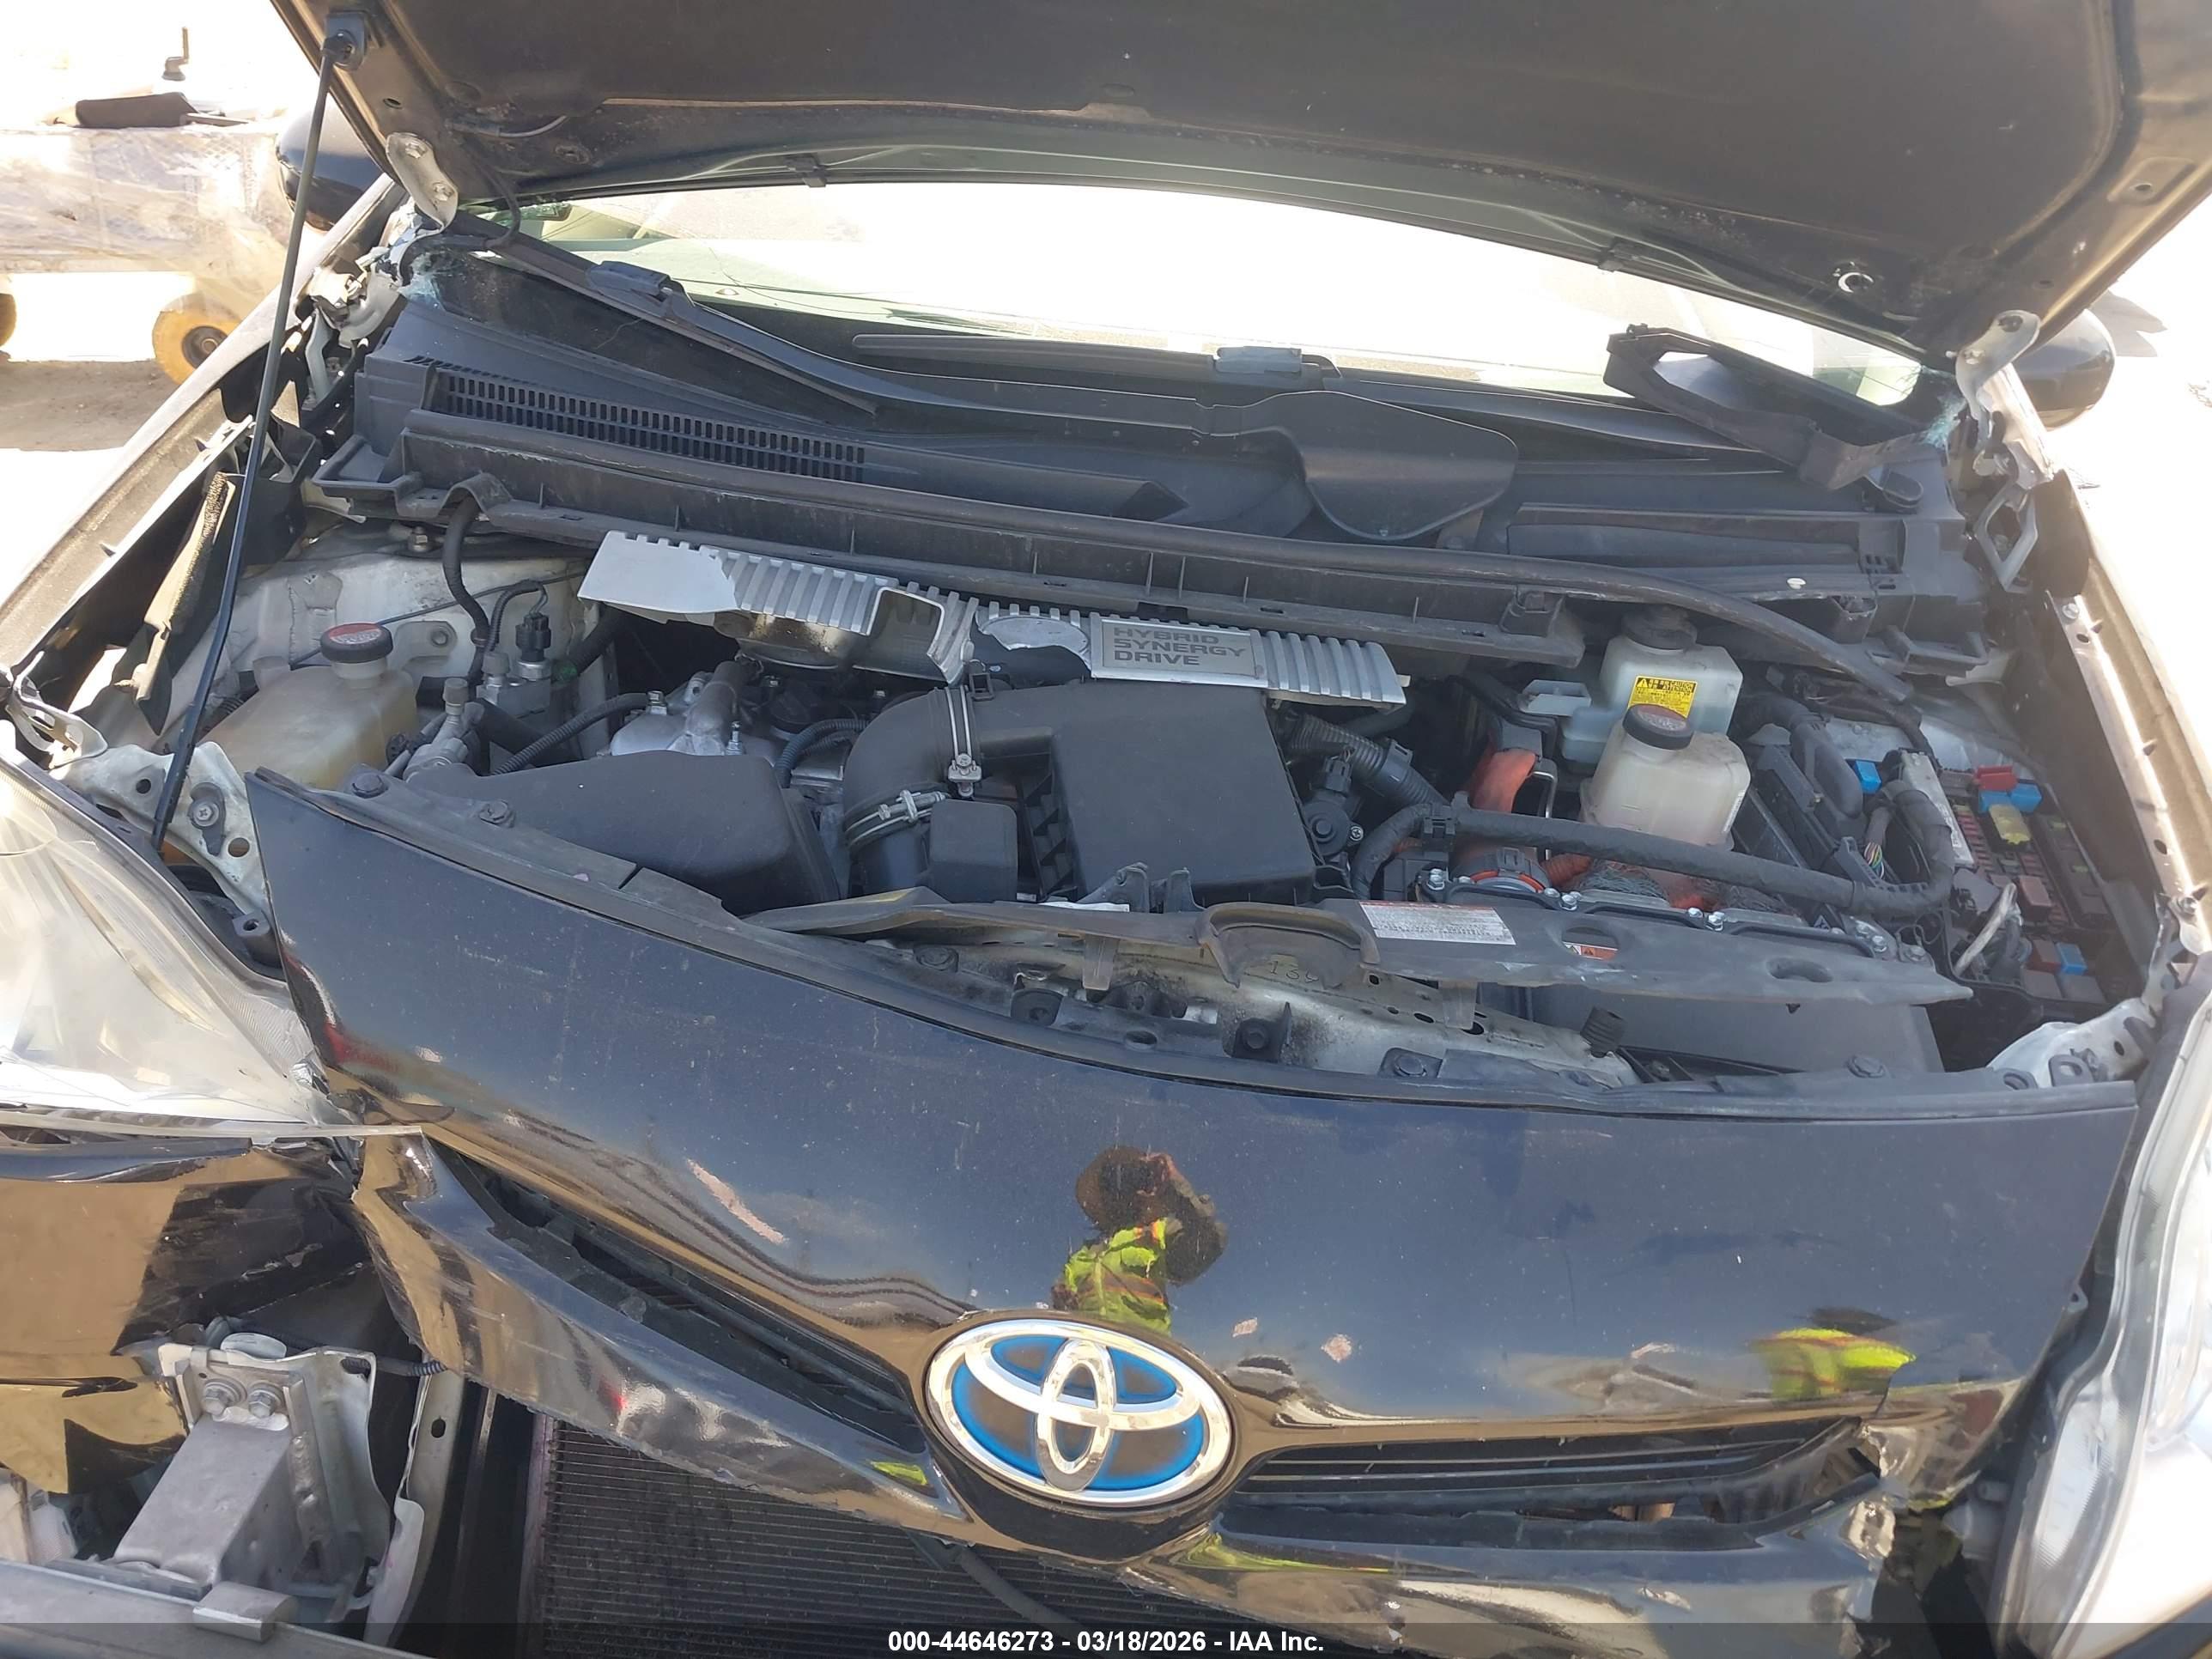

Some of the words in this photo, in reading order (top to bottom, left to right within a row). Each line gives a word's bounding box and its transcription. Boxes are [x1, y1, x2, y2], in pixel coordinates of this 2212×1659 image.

[1113, 627, 1219, 644] HYBRID
[1113, 638, 1246, 657] SYNERGY
[1114, 650, 1200, 665] DRIVE
[1669, 680, 1694, 690] CAUTION
